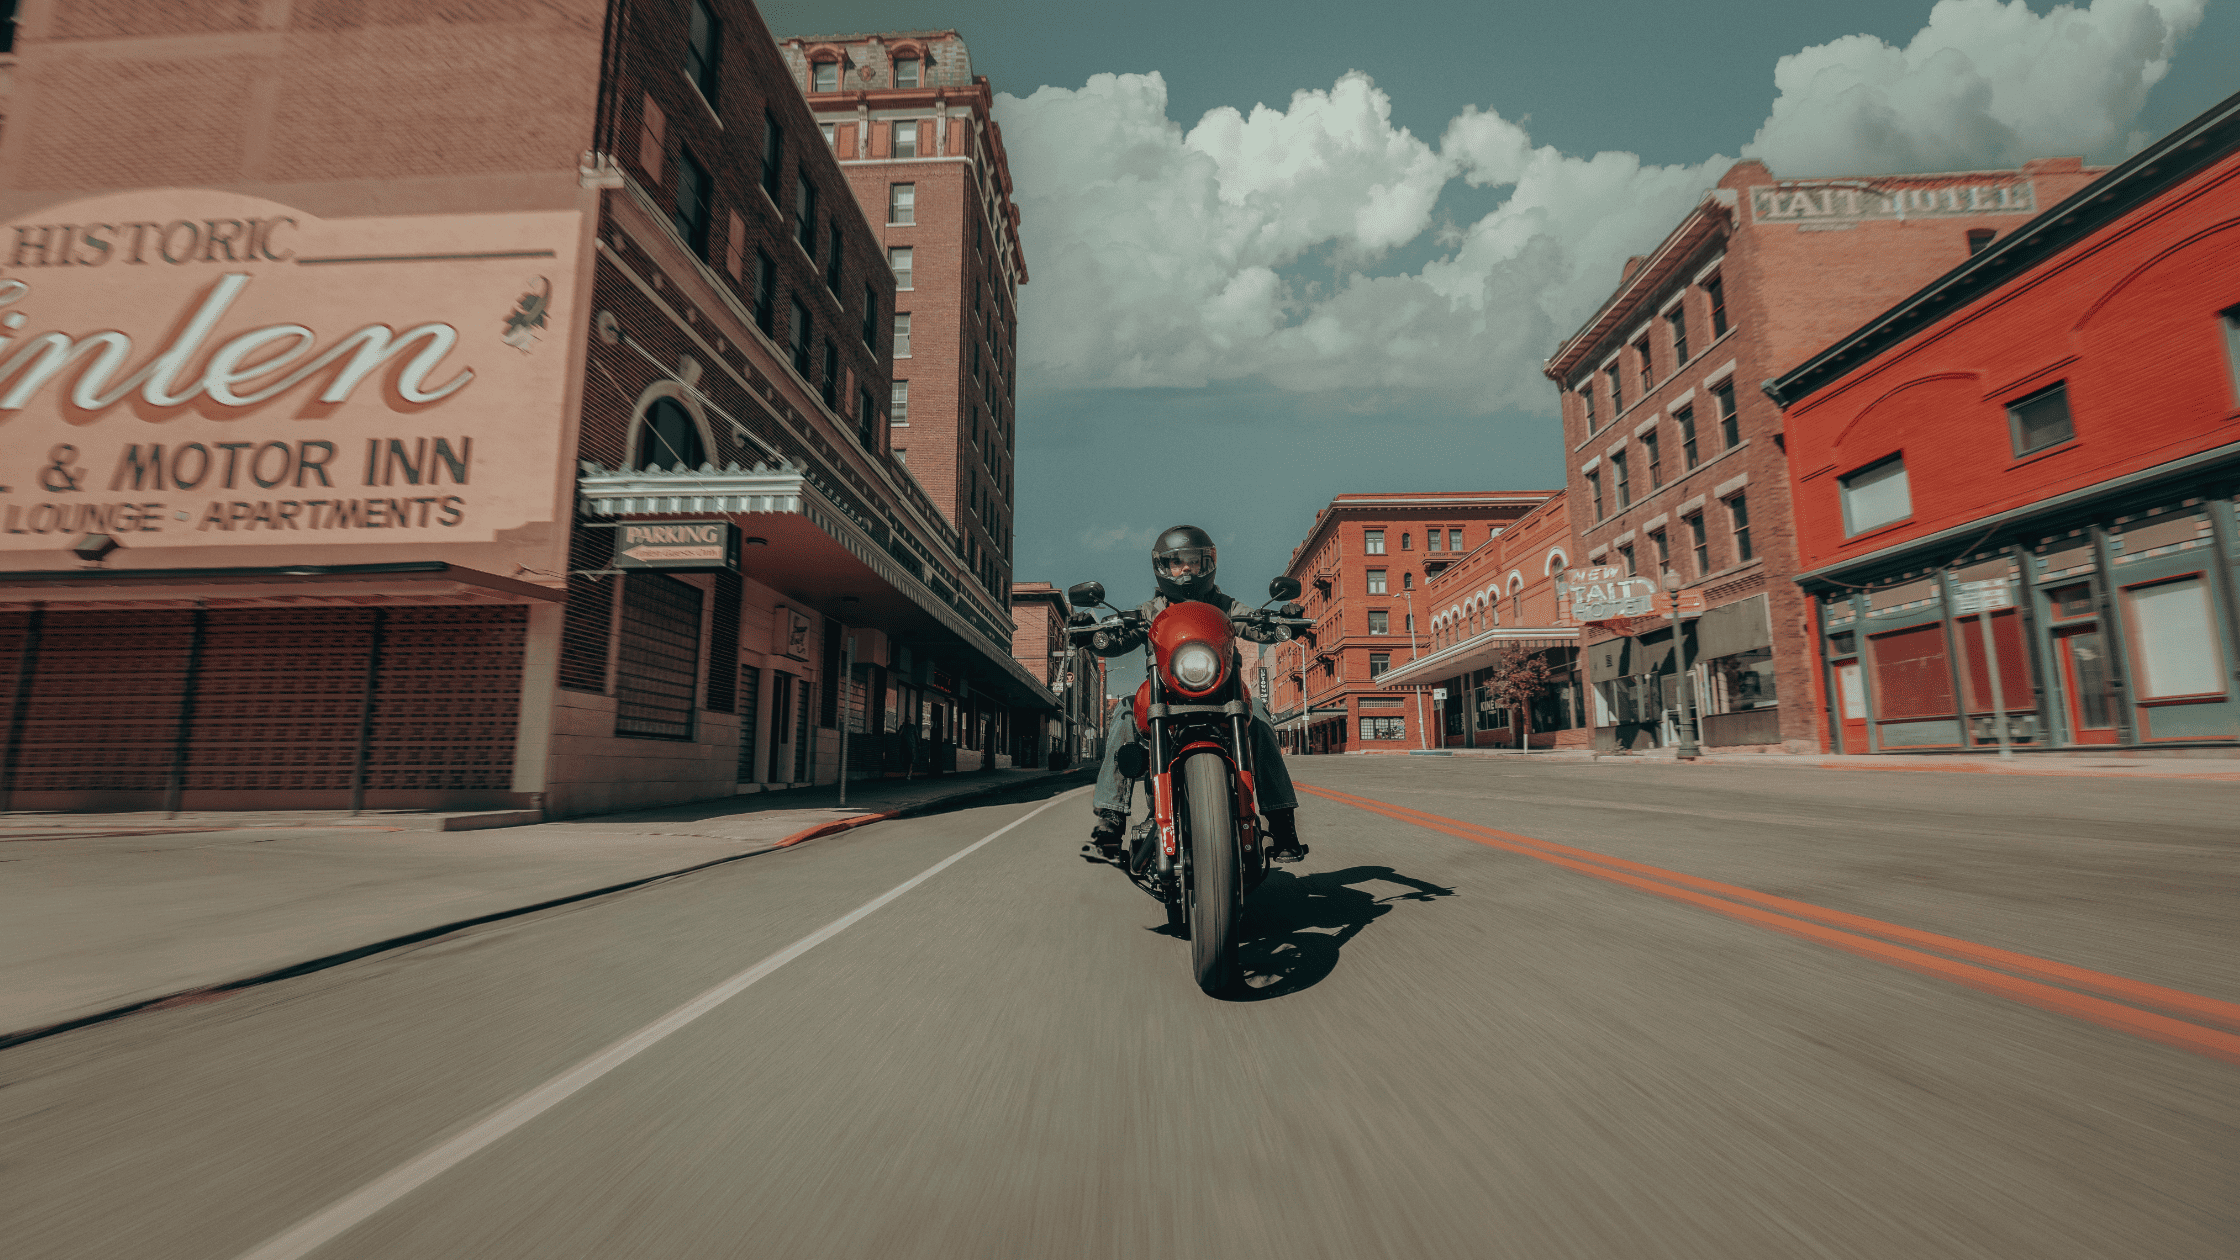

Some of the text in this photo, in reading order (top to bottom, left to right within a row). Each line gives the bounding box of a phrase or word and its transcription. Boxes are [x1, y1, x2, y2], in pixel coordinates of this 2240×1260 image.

[1757, 188, 1865, 218] TAIT
[4, 215, 298, 268] HISTORIC
[0, 271, 476, 410] nlen
[36, 436, 474, 493] & MOTOR INN
[3, 496, 466, 535] LOUNGE APARTMENTS
[626, 525, 718, 544] PARKING
[1569, 580, 1636, 604] TAIT
[1571, 567, 1619, 584] NEW
